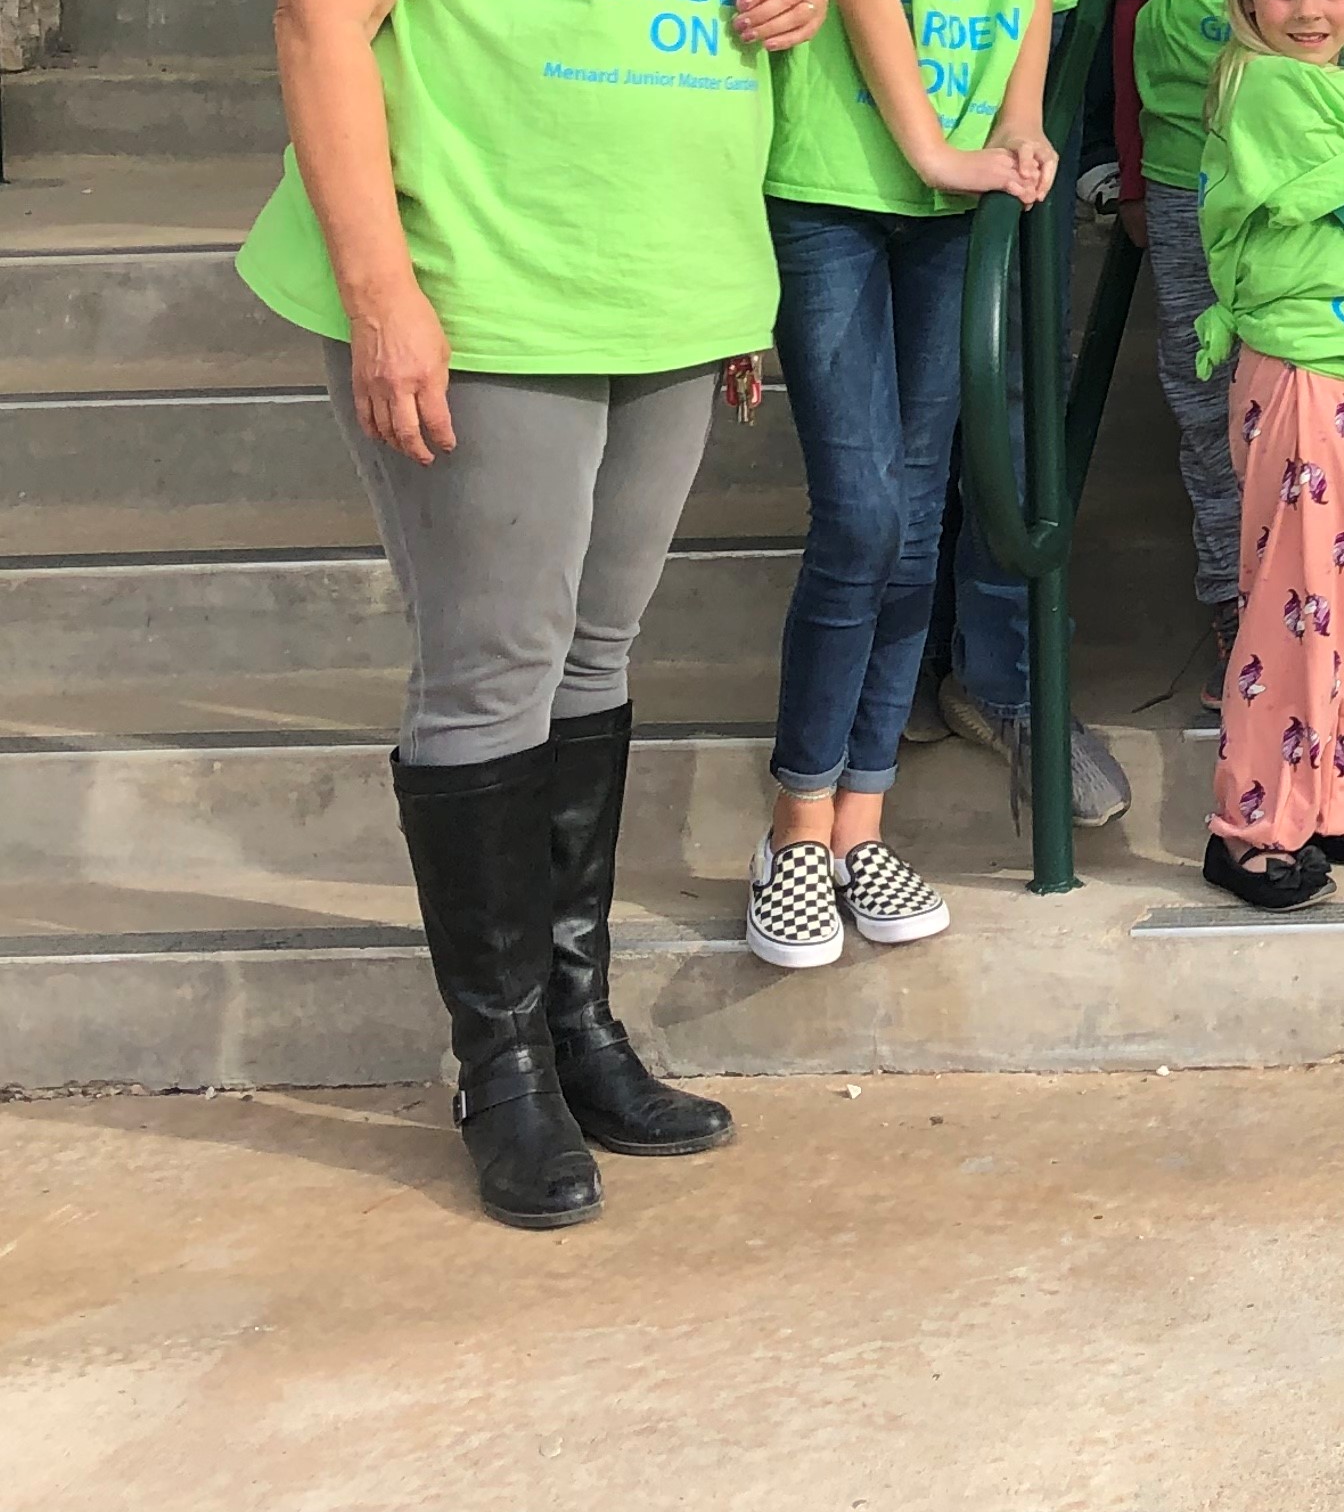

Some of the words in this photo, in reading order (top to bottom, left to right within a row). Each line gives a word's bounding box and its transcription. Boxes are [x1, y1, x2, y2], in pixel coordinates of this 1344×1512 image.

[649, 12, 719, 57] ON
[543, 62, 618, 84] Menard
[624, 70, 675, 87] Junior
[678, 73, 722, 90] Master
[916, 59, 969, 95] ON
